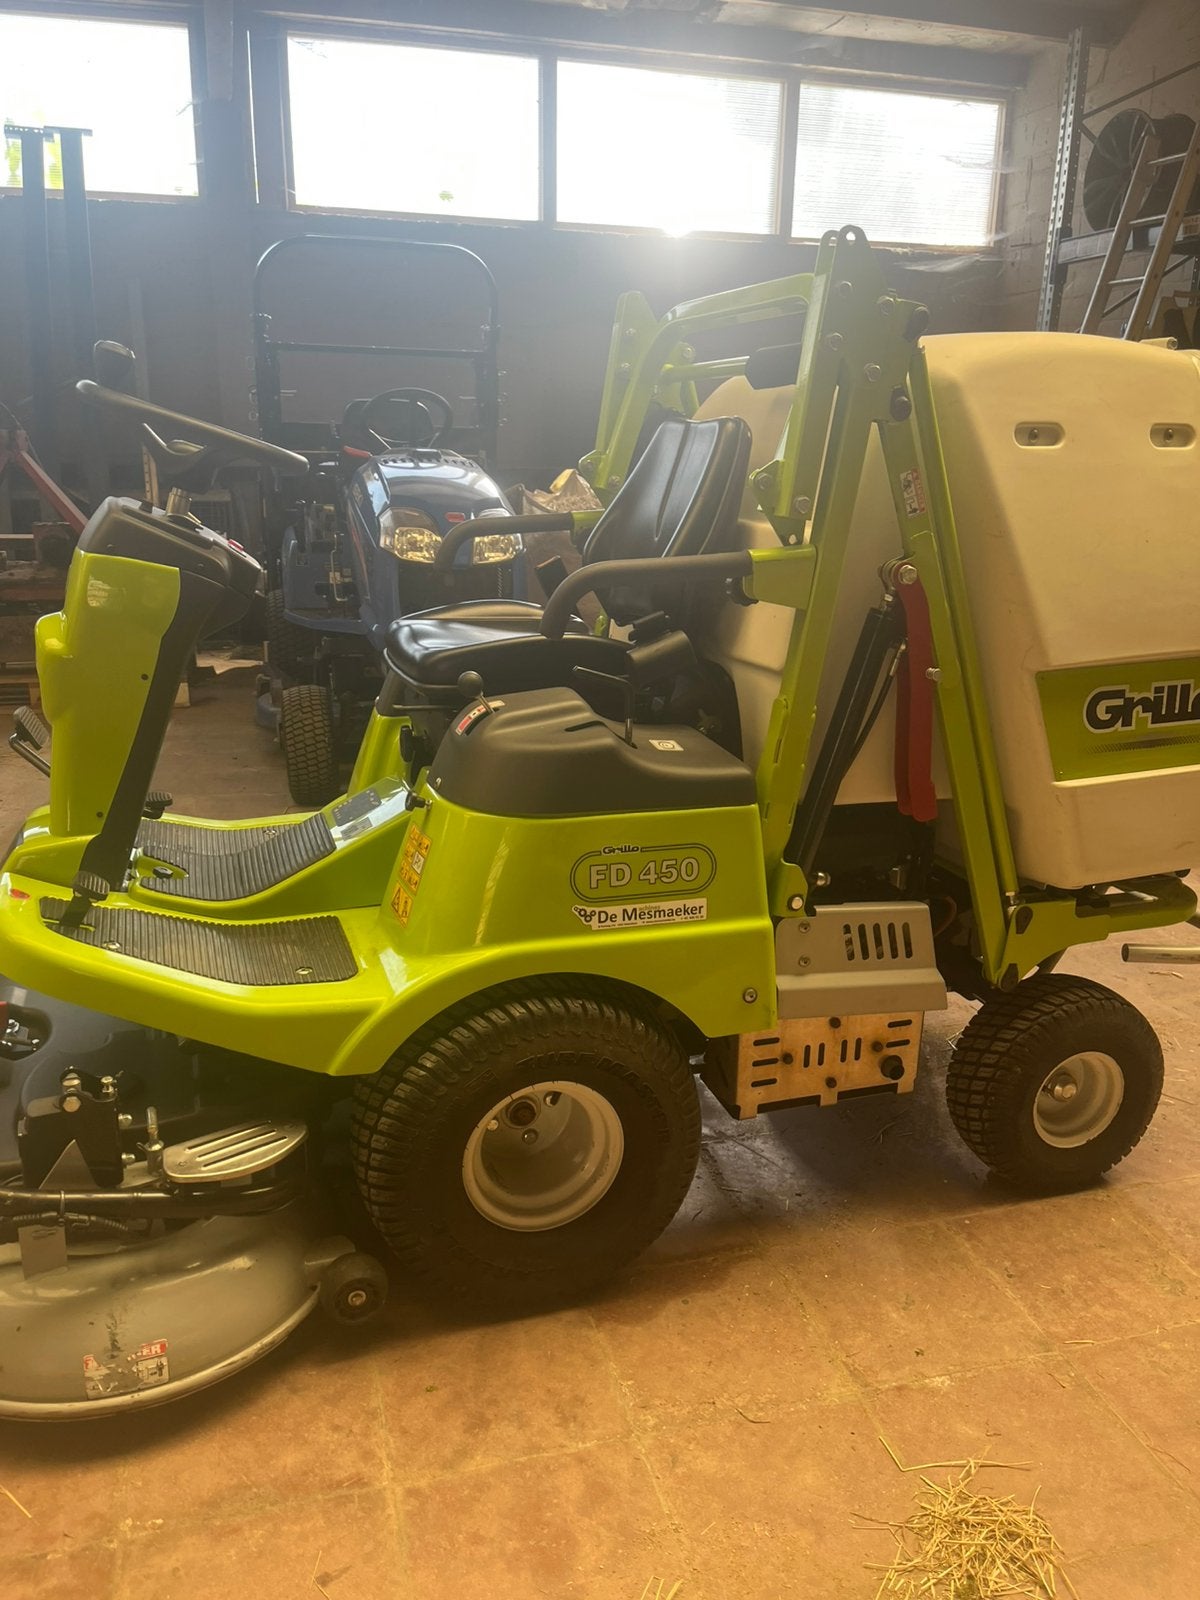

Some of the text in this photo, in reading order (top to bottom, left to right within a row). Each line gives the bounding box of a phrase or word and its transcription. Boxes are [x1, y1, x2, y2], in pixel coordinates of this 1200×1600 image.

[602, 845, 640, 855] Grillo
[589, 856, 699, 889] FD 450
[598, 904, 704, 924] De Mesmaeker
